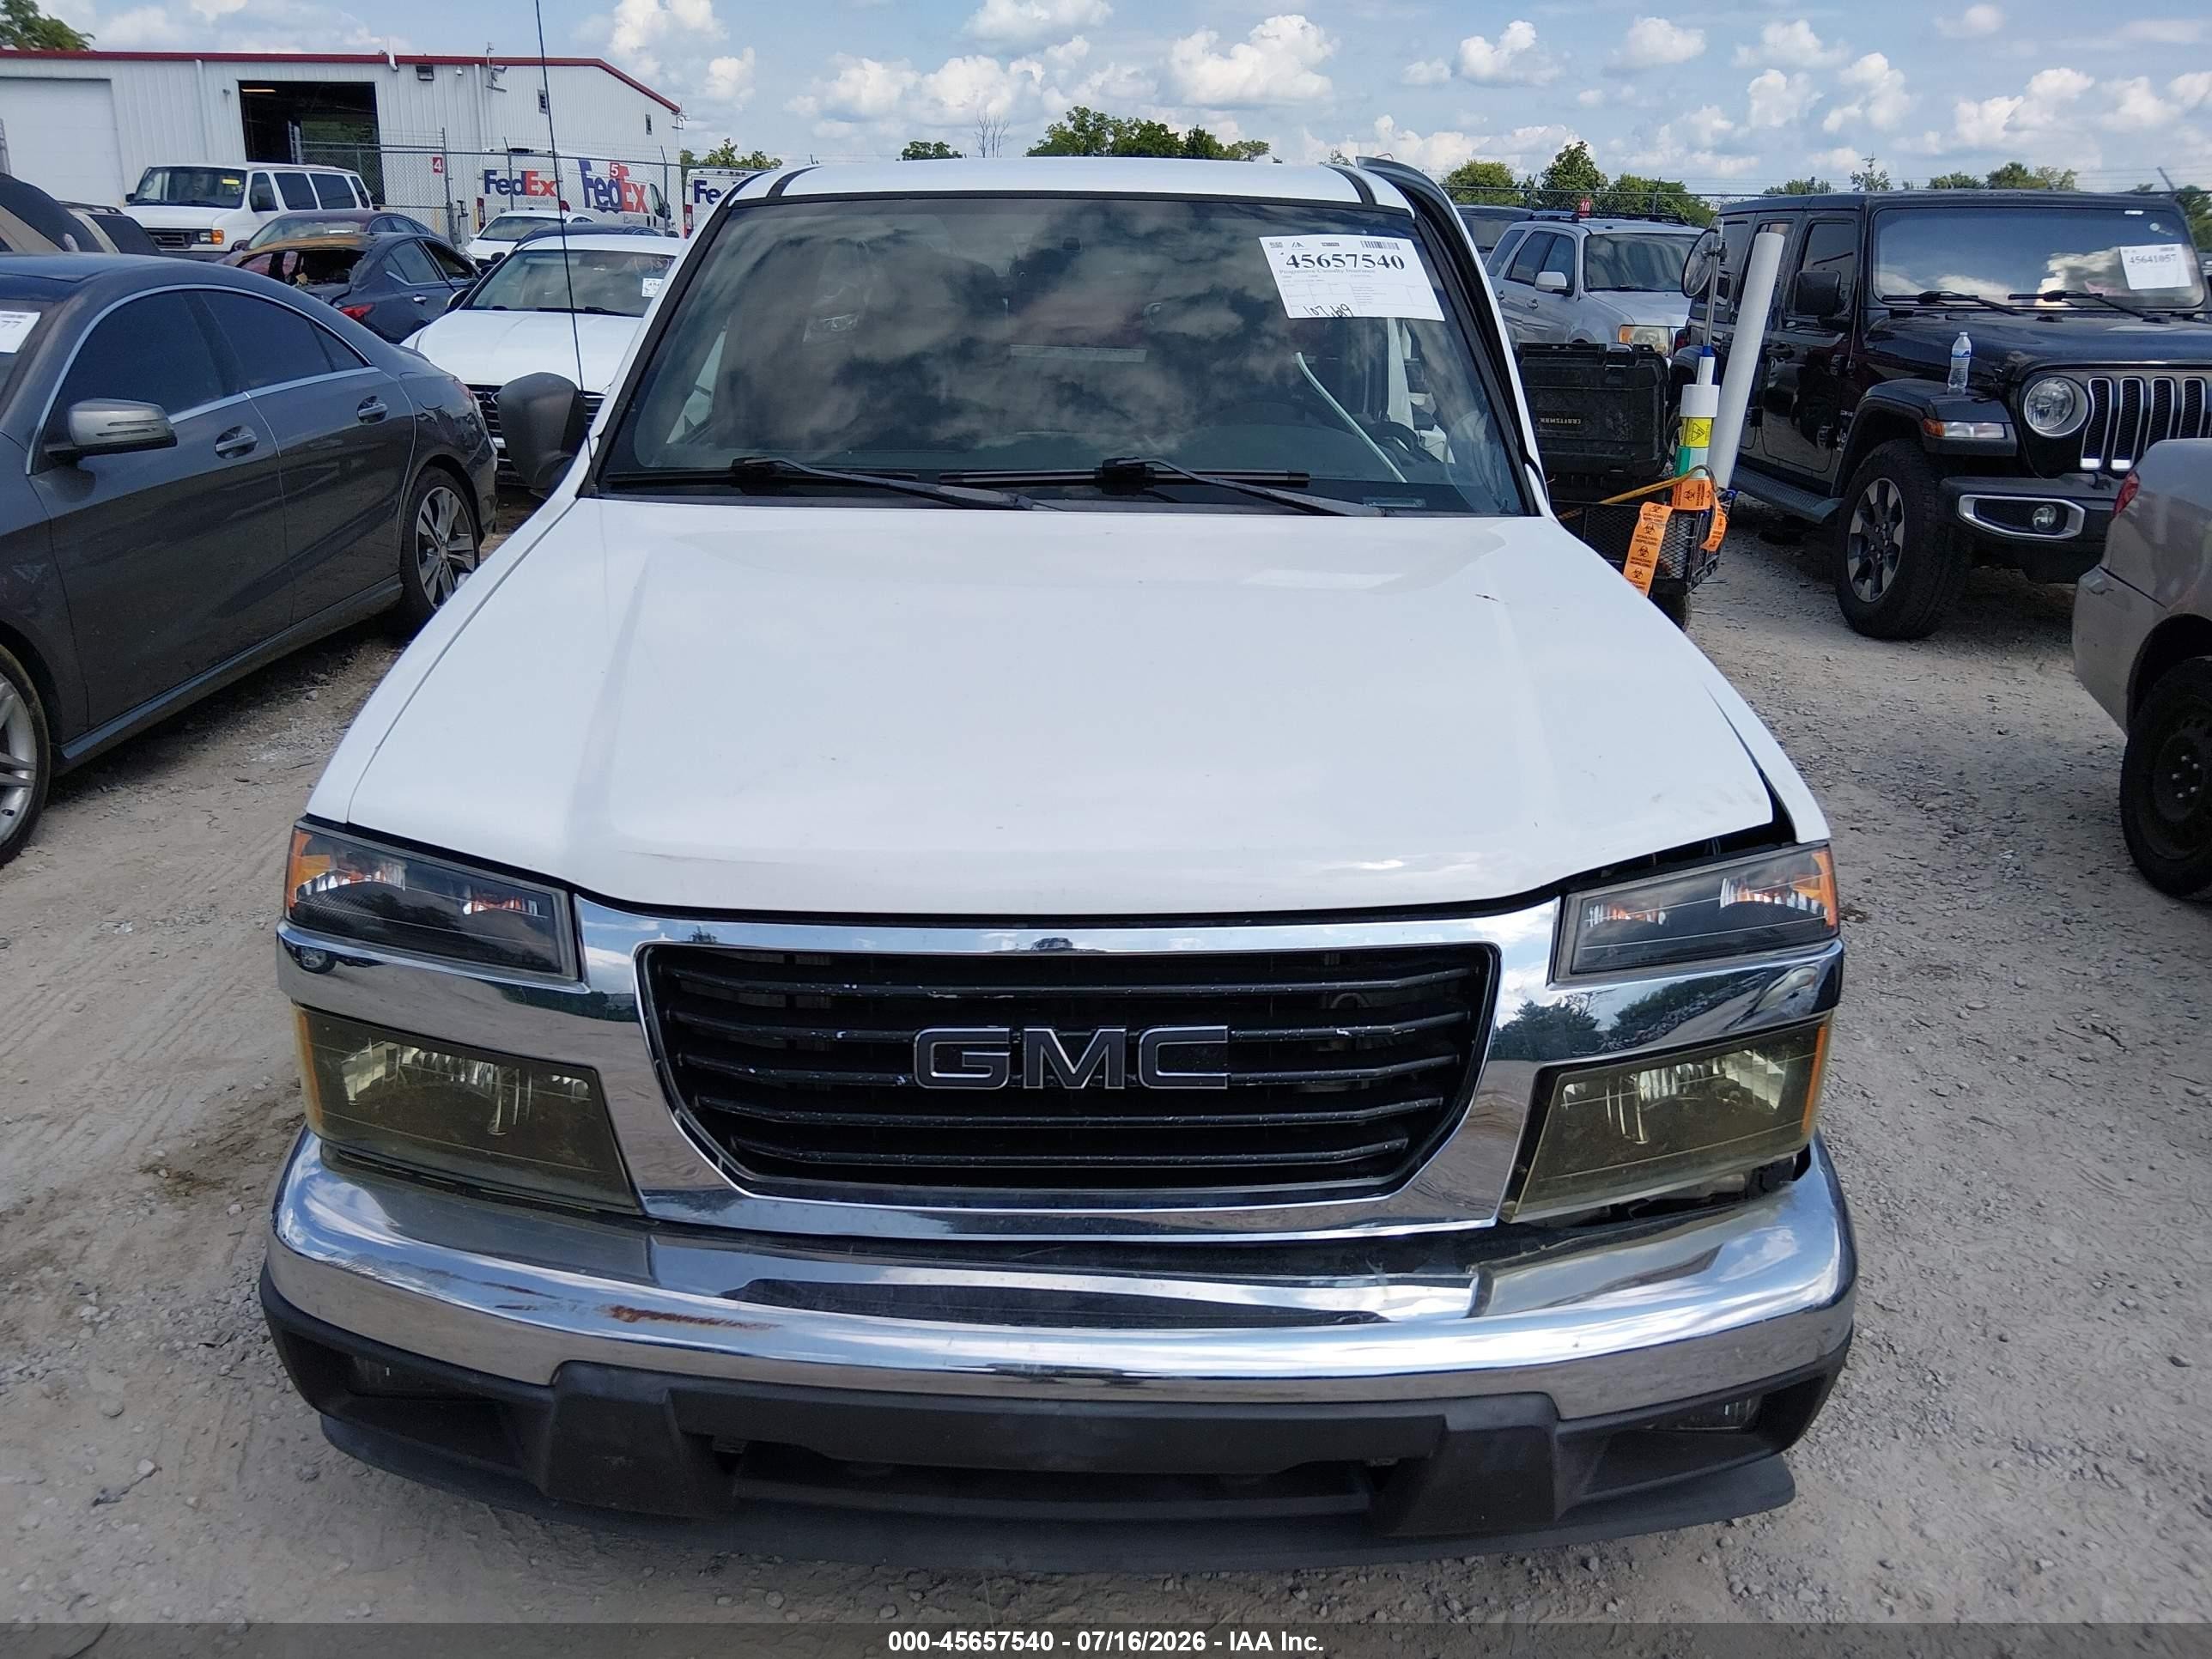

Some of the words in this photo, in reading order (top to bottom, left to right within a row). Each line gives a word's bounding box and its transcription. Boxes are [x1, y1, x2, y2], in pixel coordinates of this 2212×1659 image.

[434, 159, 442, 171] 4
[611, 164, 619, 177] 5
[484, 170, 556, 197] FedEx
[579, 159, 649, 213] FedEx
[1580, 201, 1589, 211] 10
[1285, 253, 1405, 270] 45657540
[913, 1025, 1229, 1090] GMC
